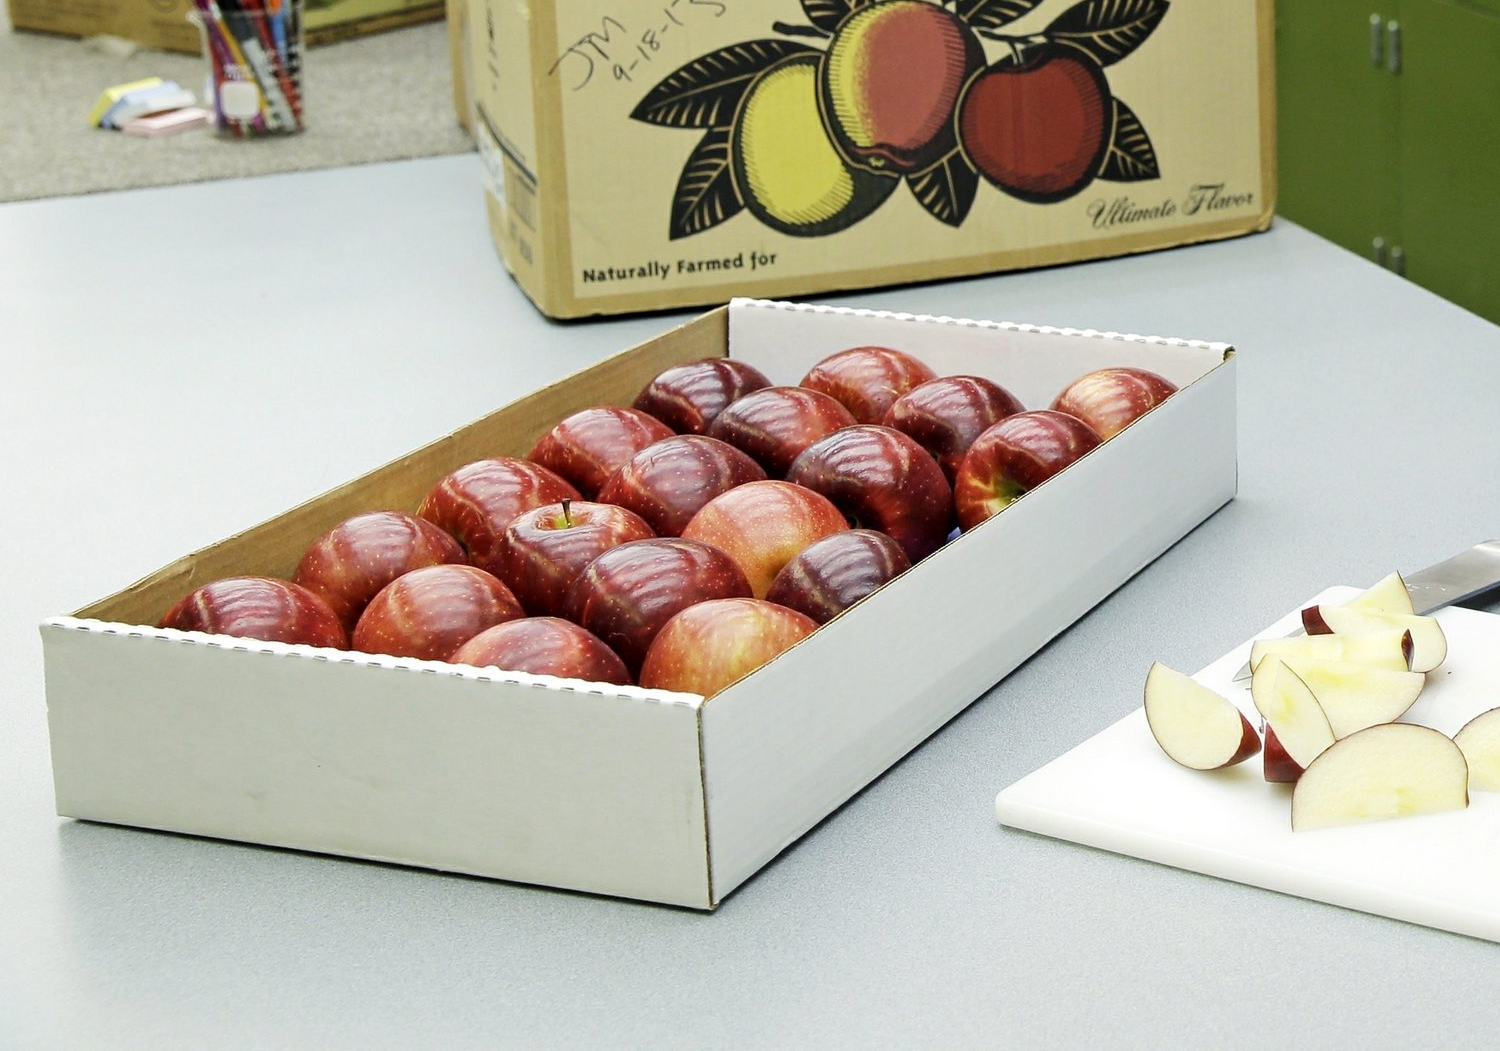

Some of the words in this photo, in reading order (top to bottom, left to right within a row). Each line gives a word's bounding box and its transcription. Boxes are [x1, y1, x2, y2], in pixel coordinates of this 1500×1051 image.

[1087, 196, 1176, 230] Ultimate
[1181, 182, 1253, 217] Flavor
[582, 261, 670, 284] Naturally
[677, 253, 743, 274] Farmed
[750, 251, 777, 271] for
